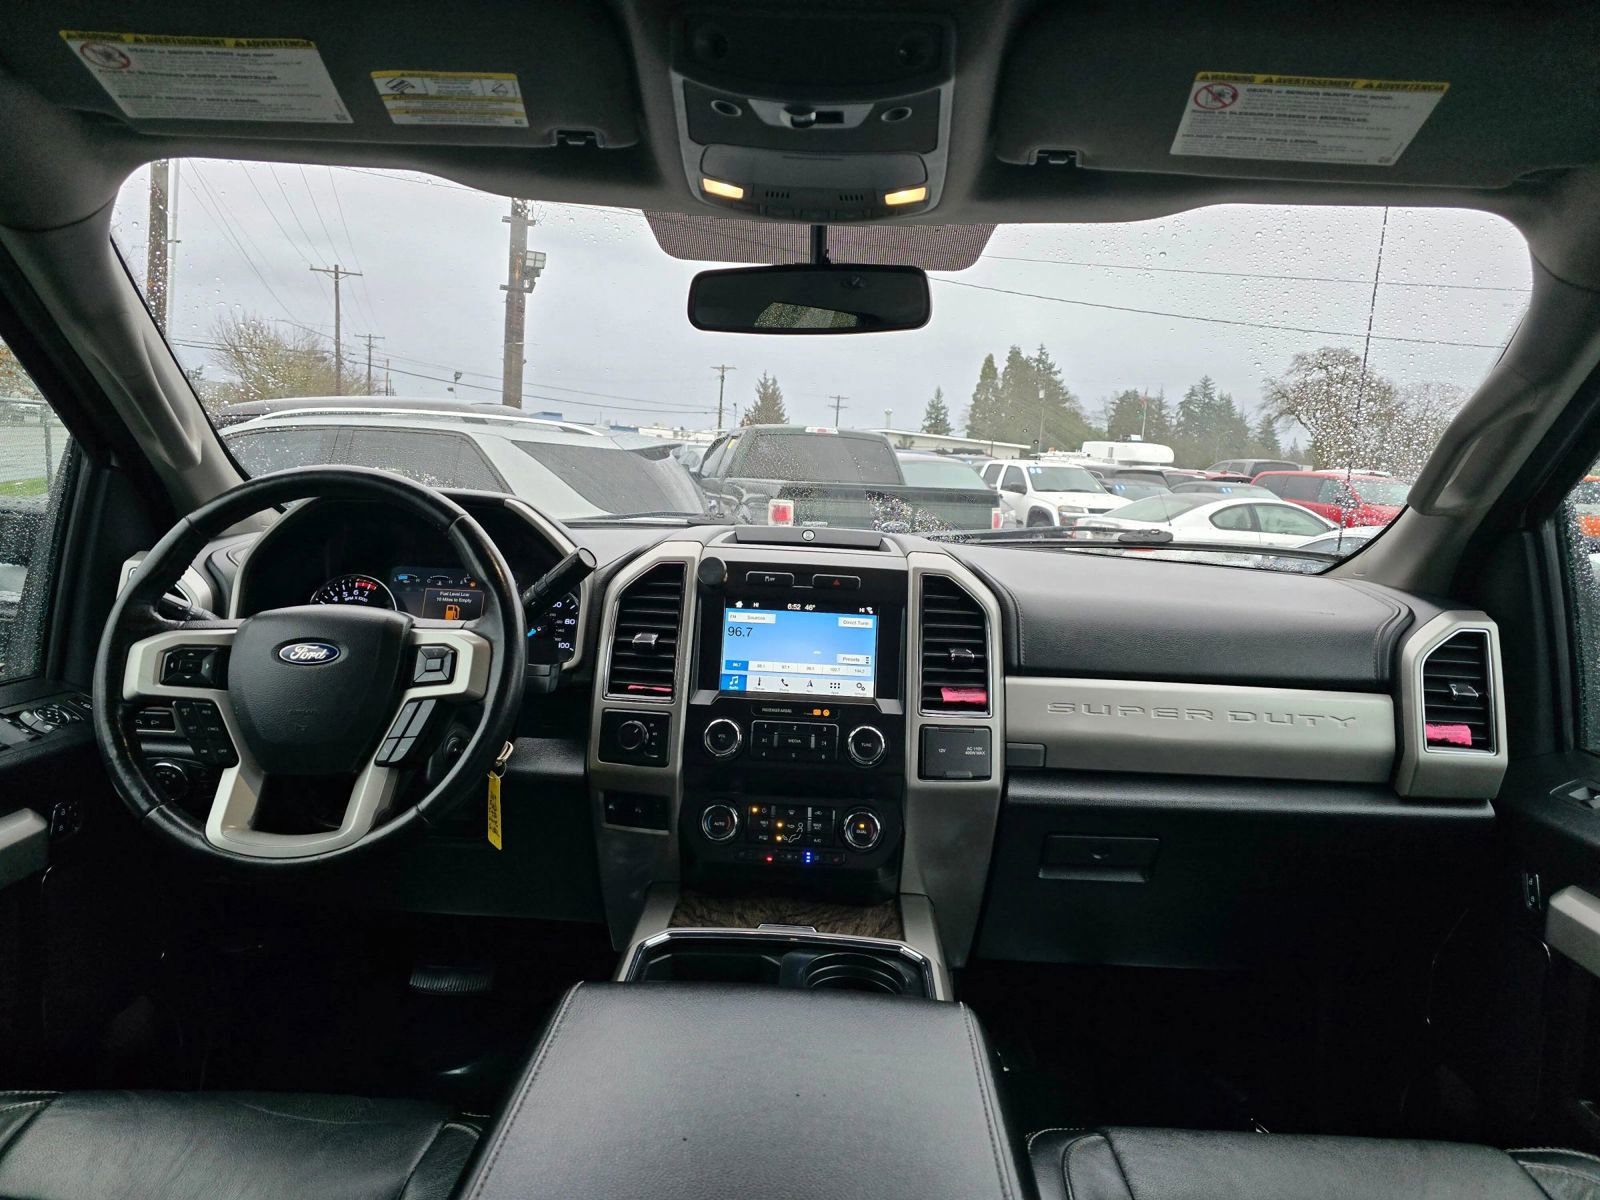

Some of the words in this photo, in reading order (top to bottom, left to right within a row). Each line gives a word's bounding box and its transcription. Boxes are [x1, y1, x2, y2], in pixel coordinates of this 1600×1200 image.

[246, 38, 313, 48] ADVERTENCIA
[1276, 77, 1355, 88] AVERTISSEMENT
[728, 626, 753, 638] 96.7
[290, 645, 329, 660] Ford
[1047, 702, 1214, 721] SUPER
[1227, 710, 1357, 728] DUTY
